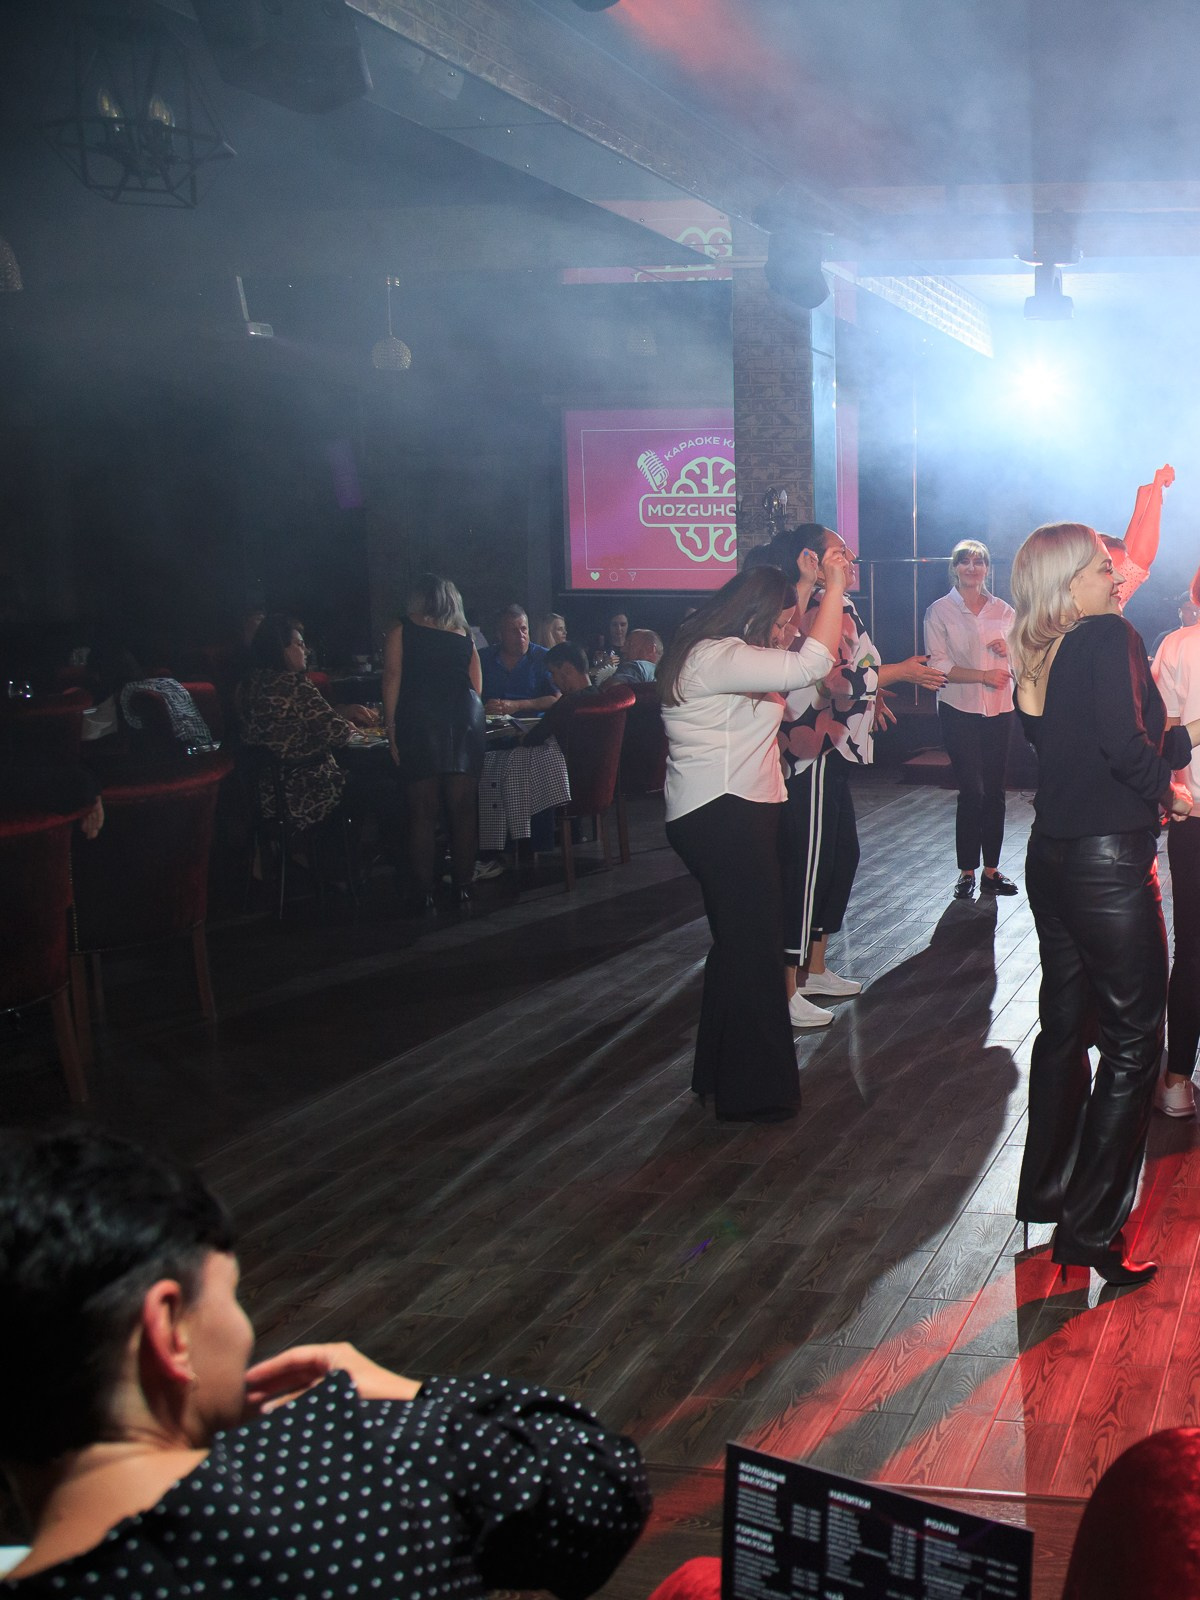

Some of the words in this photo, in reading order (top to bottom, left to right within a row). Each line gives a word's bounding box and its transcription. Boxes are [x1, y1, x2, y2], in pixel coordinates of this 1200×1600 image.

[664, 436, 720, 461] КАРАОКЕ
[739, 1472, 777, 1492] ЗАКУСКИ
[828, 1489, 871, 1510] НАПИТКИ
[924, 1517, 960, 1536] РОЛЛЫ
